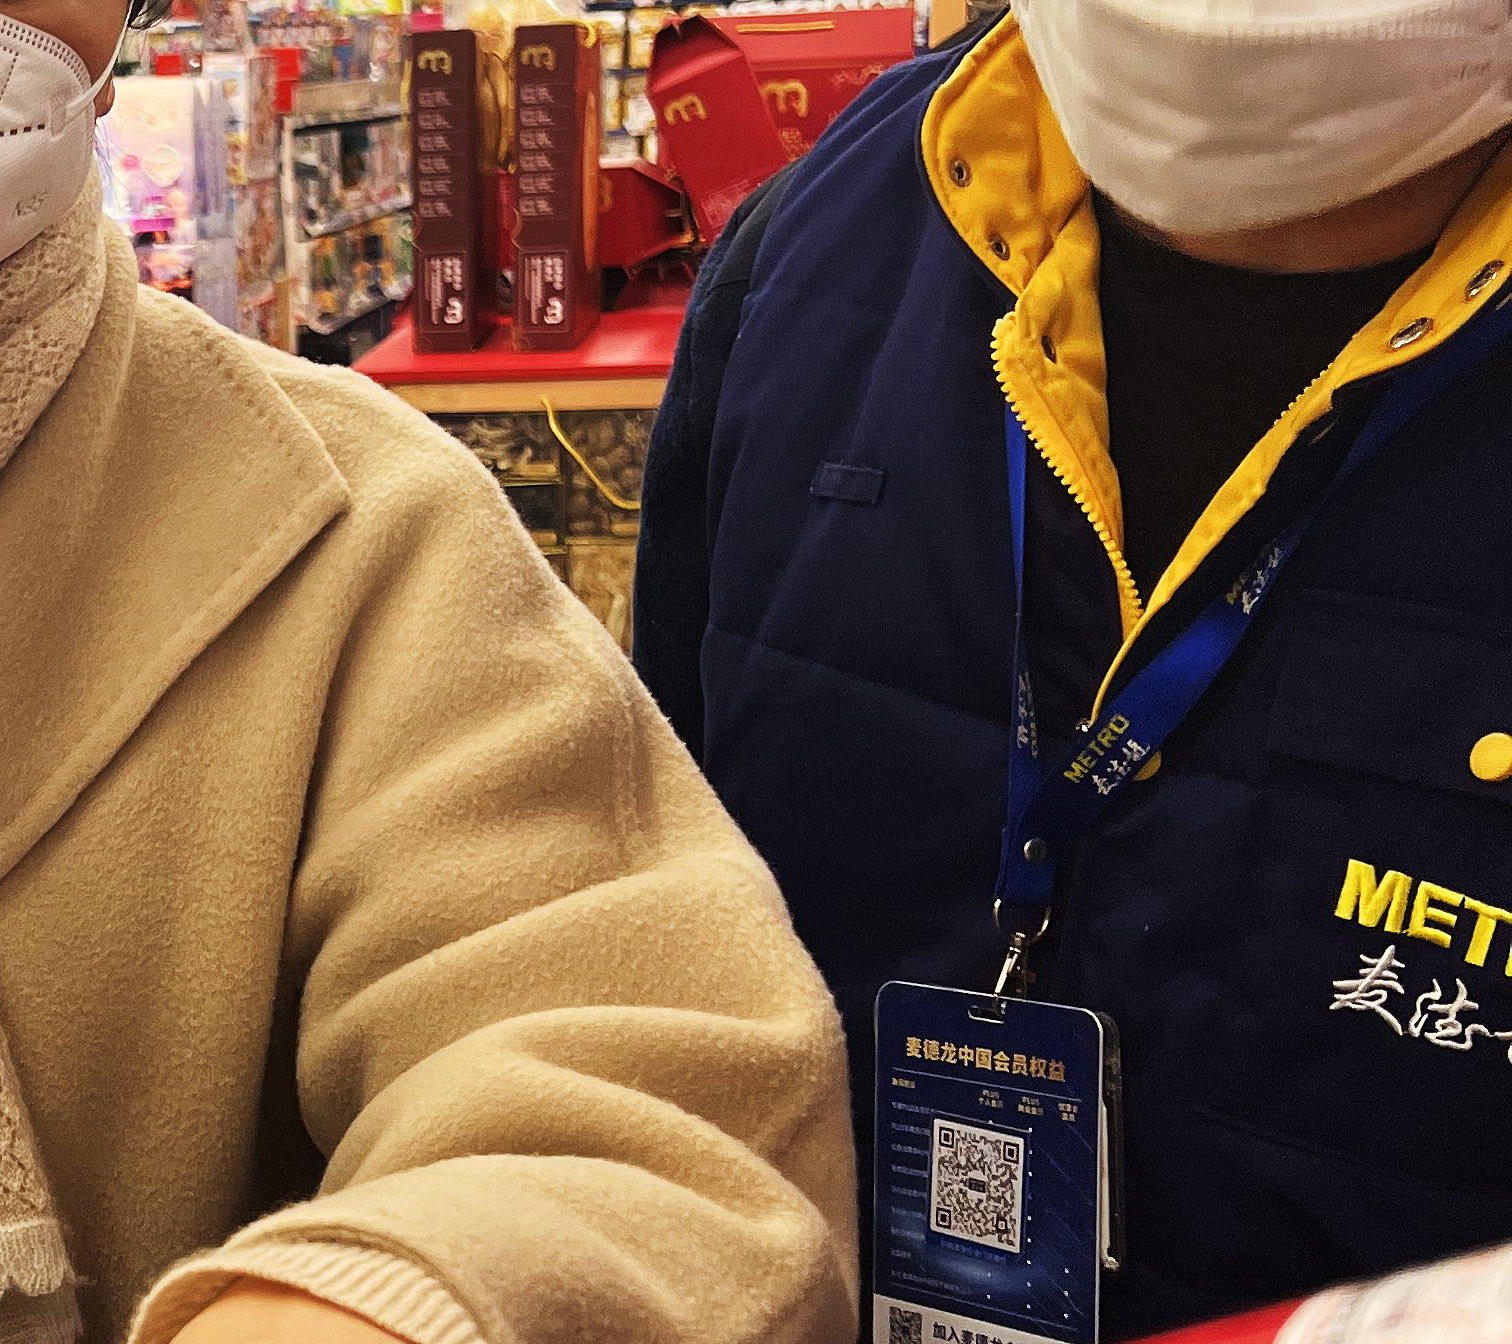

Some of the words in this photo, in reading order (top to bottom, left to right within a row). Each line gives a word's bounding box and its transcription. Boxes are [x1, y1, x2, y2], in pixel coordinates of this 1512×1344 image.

[1064, 713, 1131, 784] METRO
[1334, 858, 1512, 978] MET
[905, 1036, 1066, 1083] 麦德龙中国会员权益
